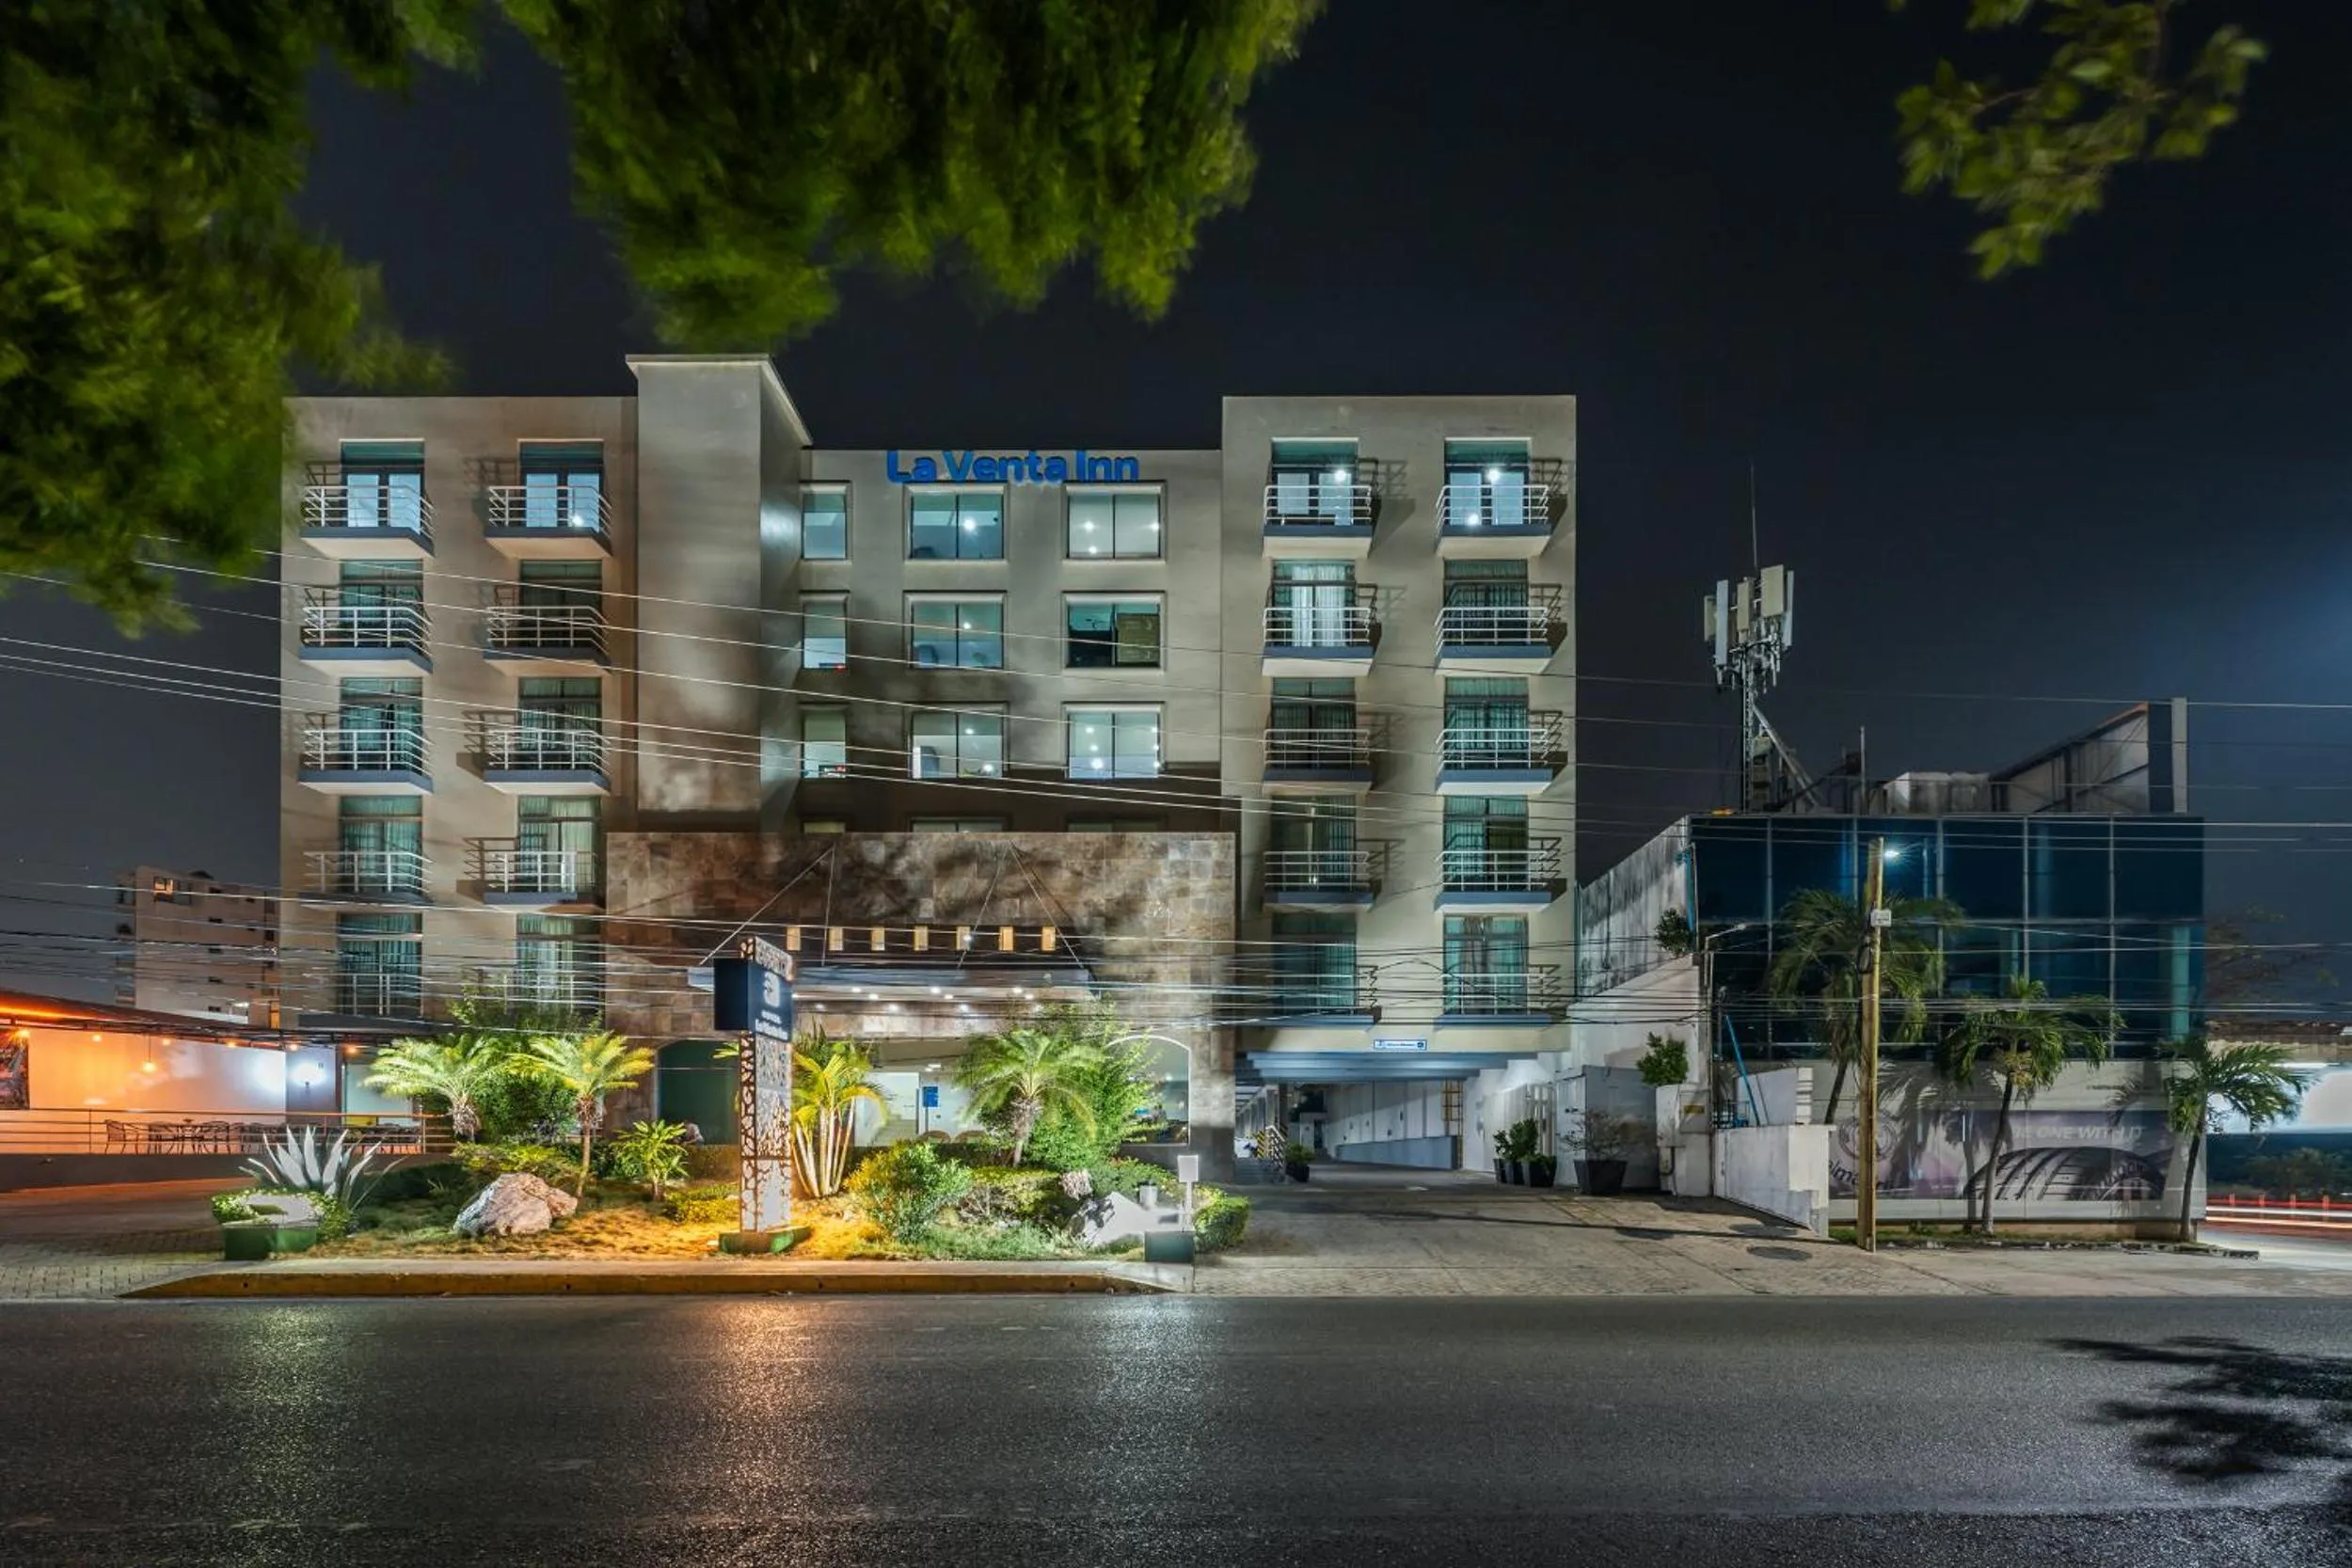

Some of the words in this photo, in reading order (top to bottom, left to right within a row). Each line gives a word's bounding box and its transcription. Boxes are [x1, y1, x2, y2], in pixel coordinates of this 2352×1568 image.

[886, 451, 936, 482] La
[943, 451, 1066, 481] Venta
[1075, 451, 1139, 481] Inn
[2036, 1126, 2073, 1139] ONE
